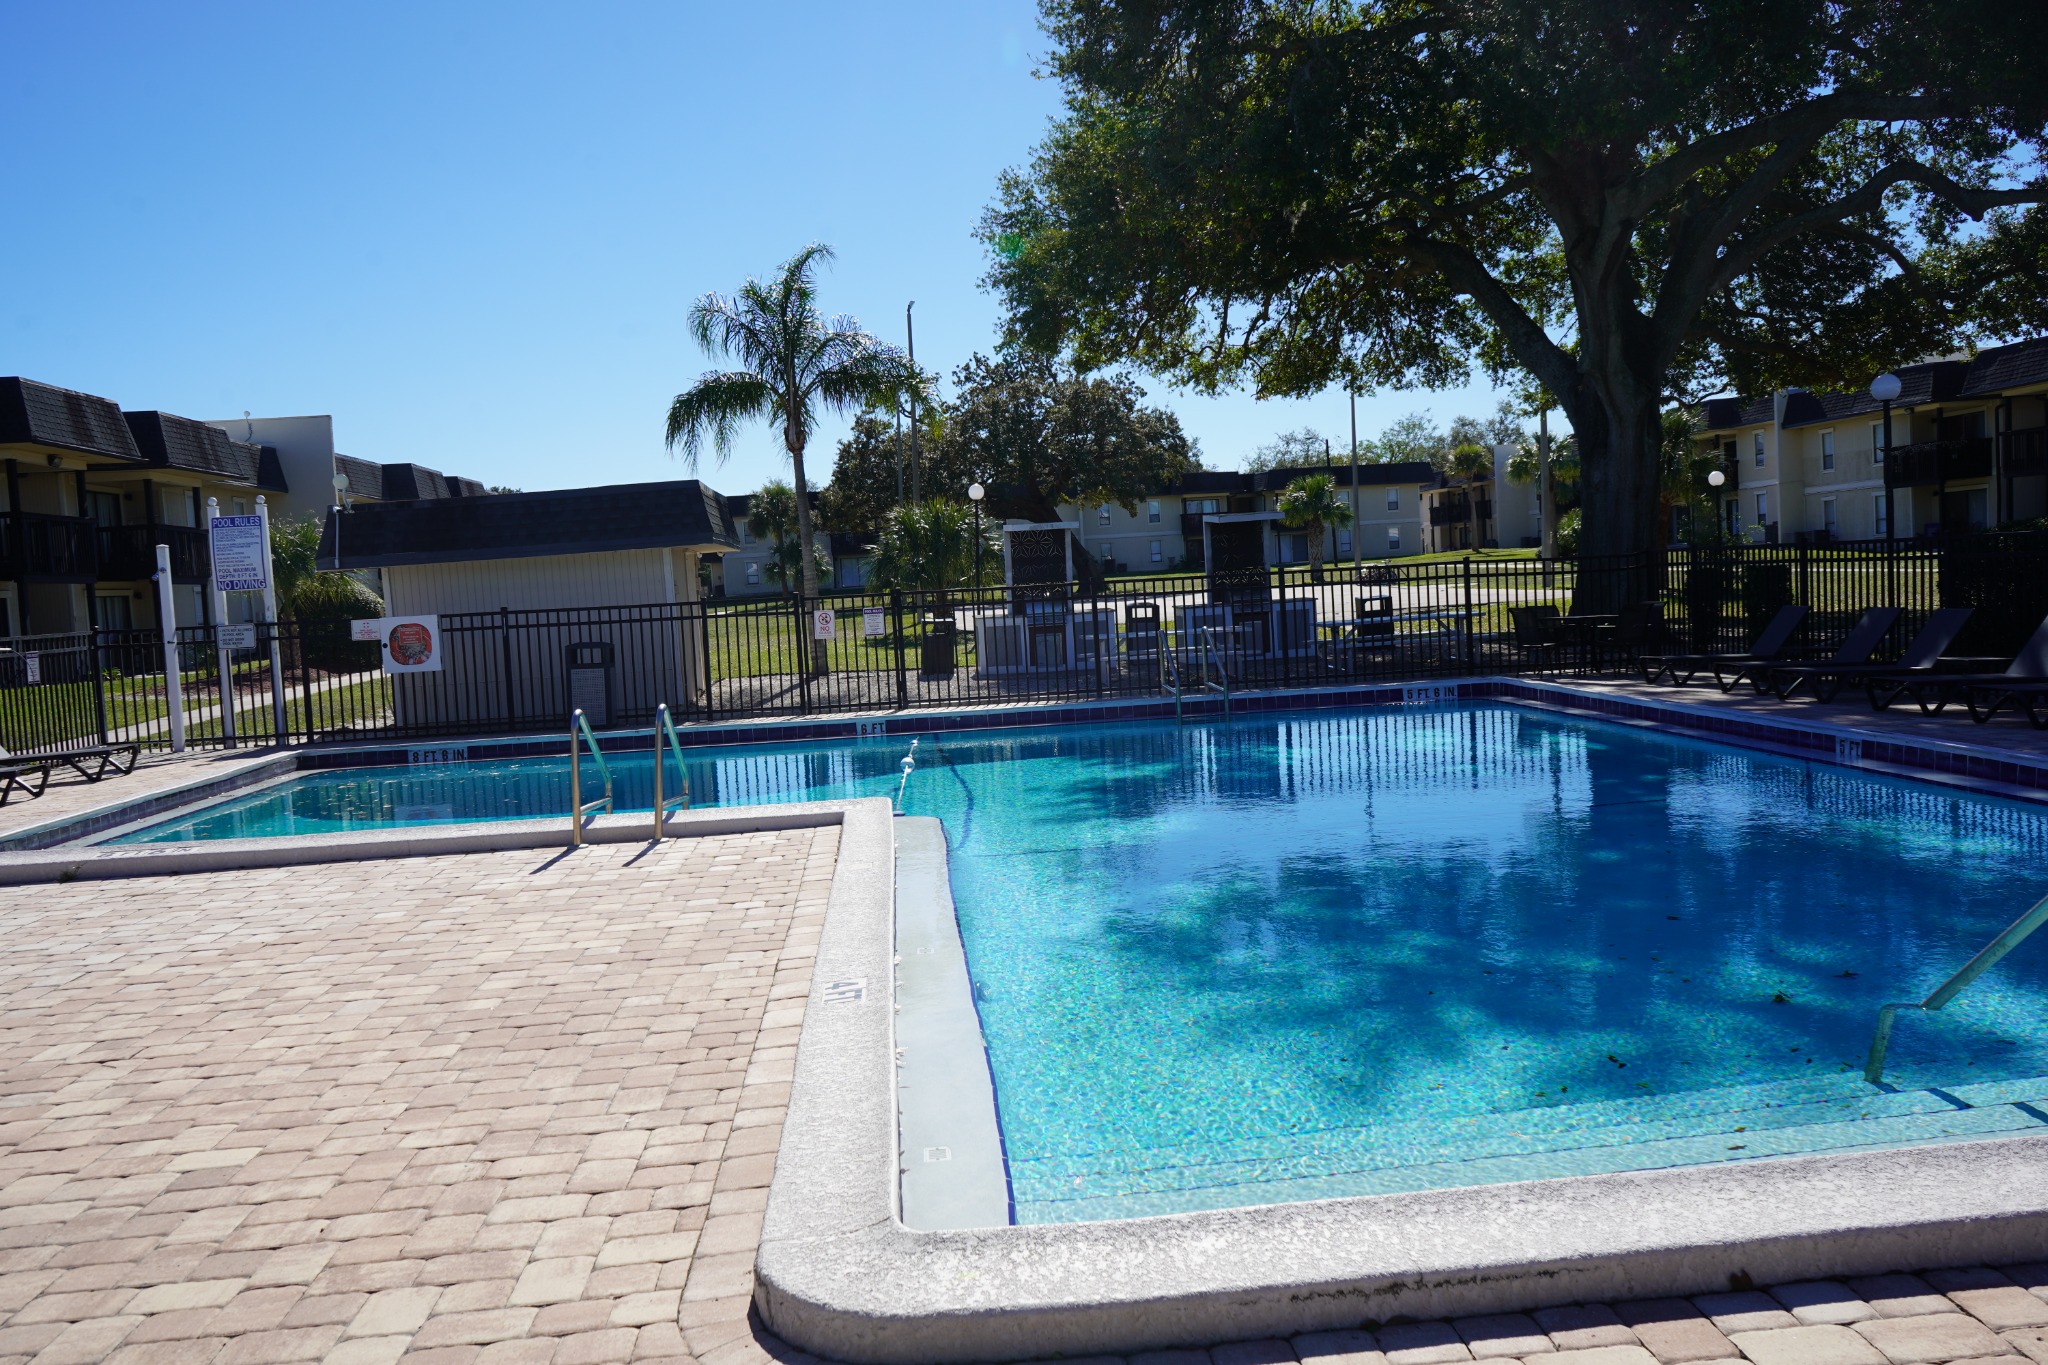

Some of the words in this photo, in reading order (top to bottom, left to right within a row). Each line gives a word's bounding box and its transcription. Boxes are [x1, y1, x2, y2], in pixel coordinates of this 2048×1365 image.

[212, 519, 233, 527] POOL
[234, 517, 260, 526] RULES
[218, 581, 231, 590] NO
[233, 580, 266, 589] DIVING
[1407, 689, 1413, 699] 5
[1417, 688, 1430, 698] FT.
[1434, 687, 1440, 697] 6
[1444, 687, 1456, 697] IN.
[861, 723, 868, 734] 6
[872, 722, 885, 734] FT.
[412, 751, 420, 763] 8
[424, 751, 437, 762] FT.
[453, 748, 466, 761] IN.
